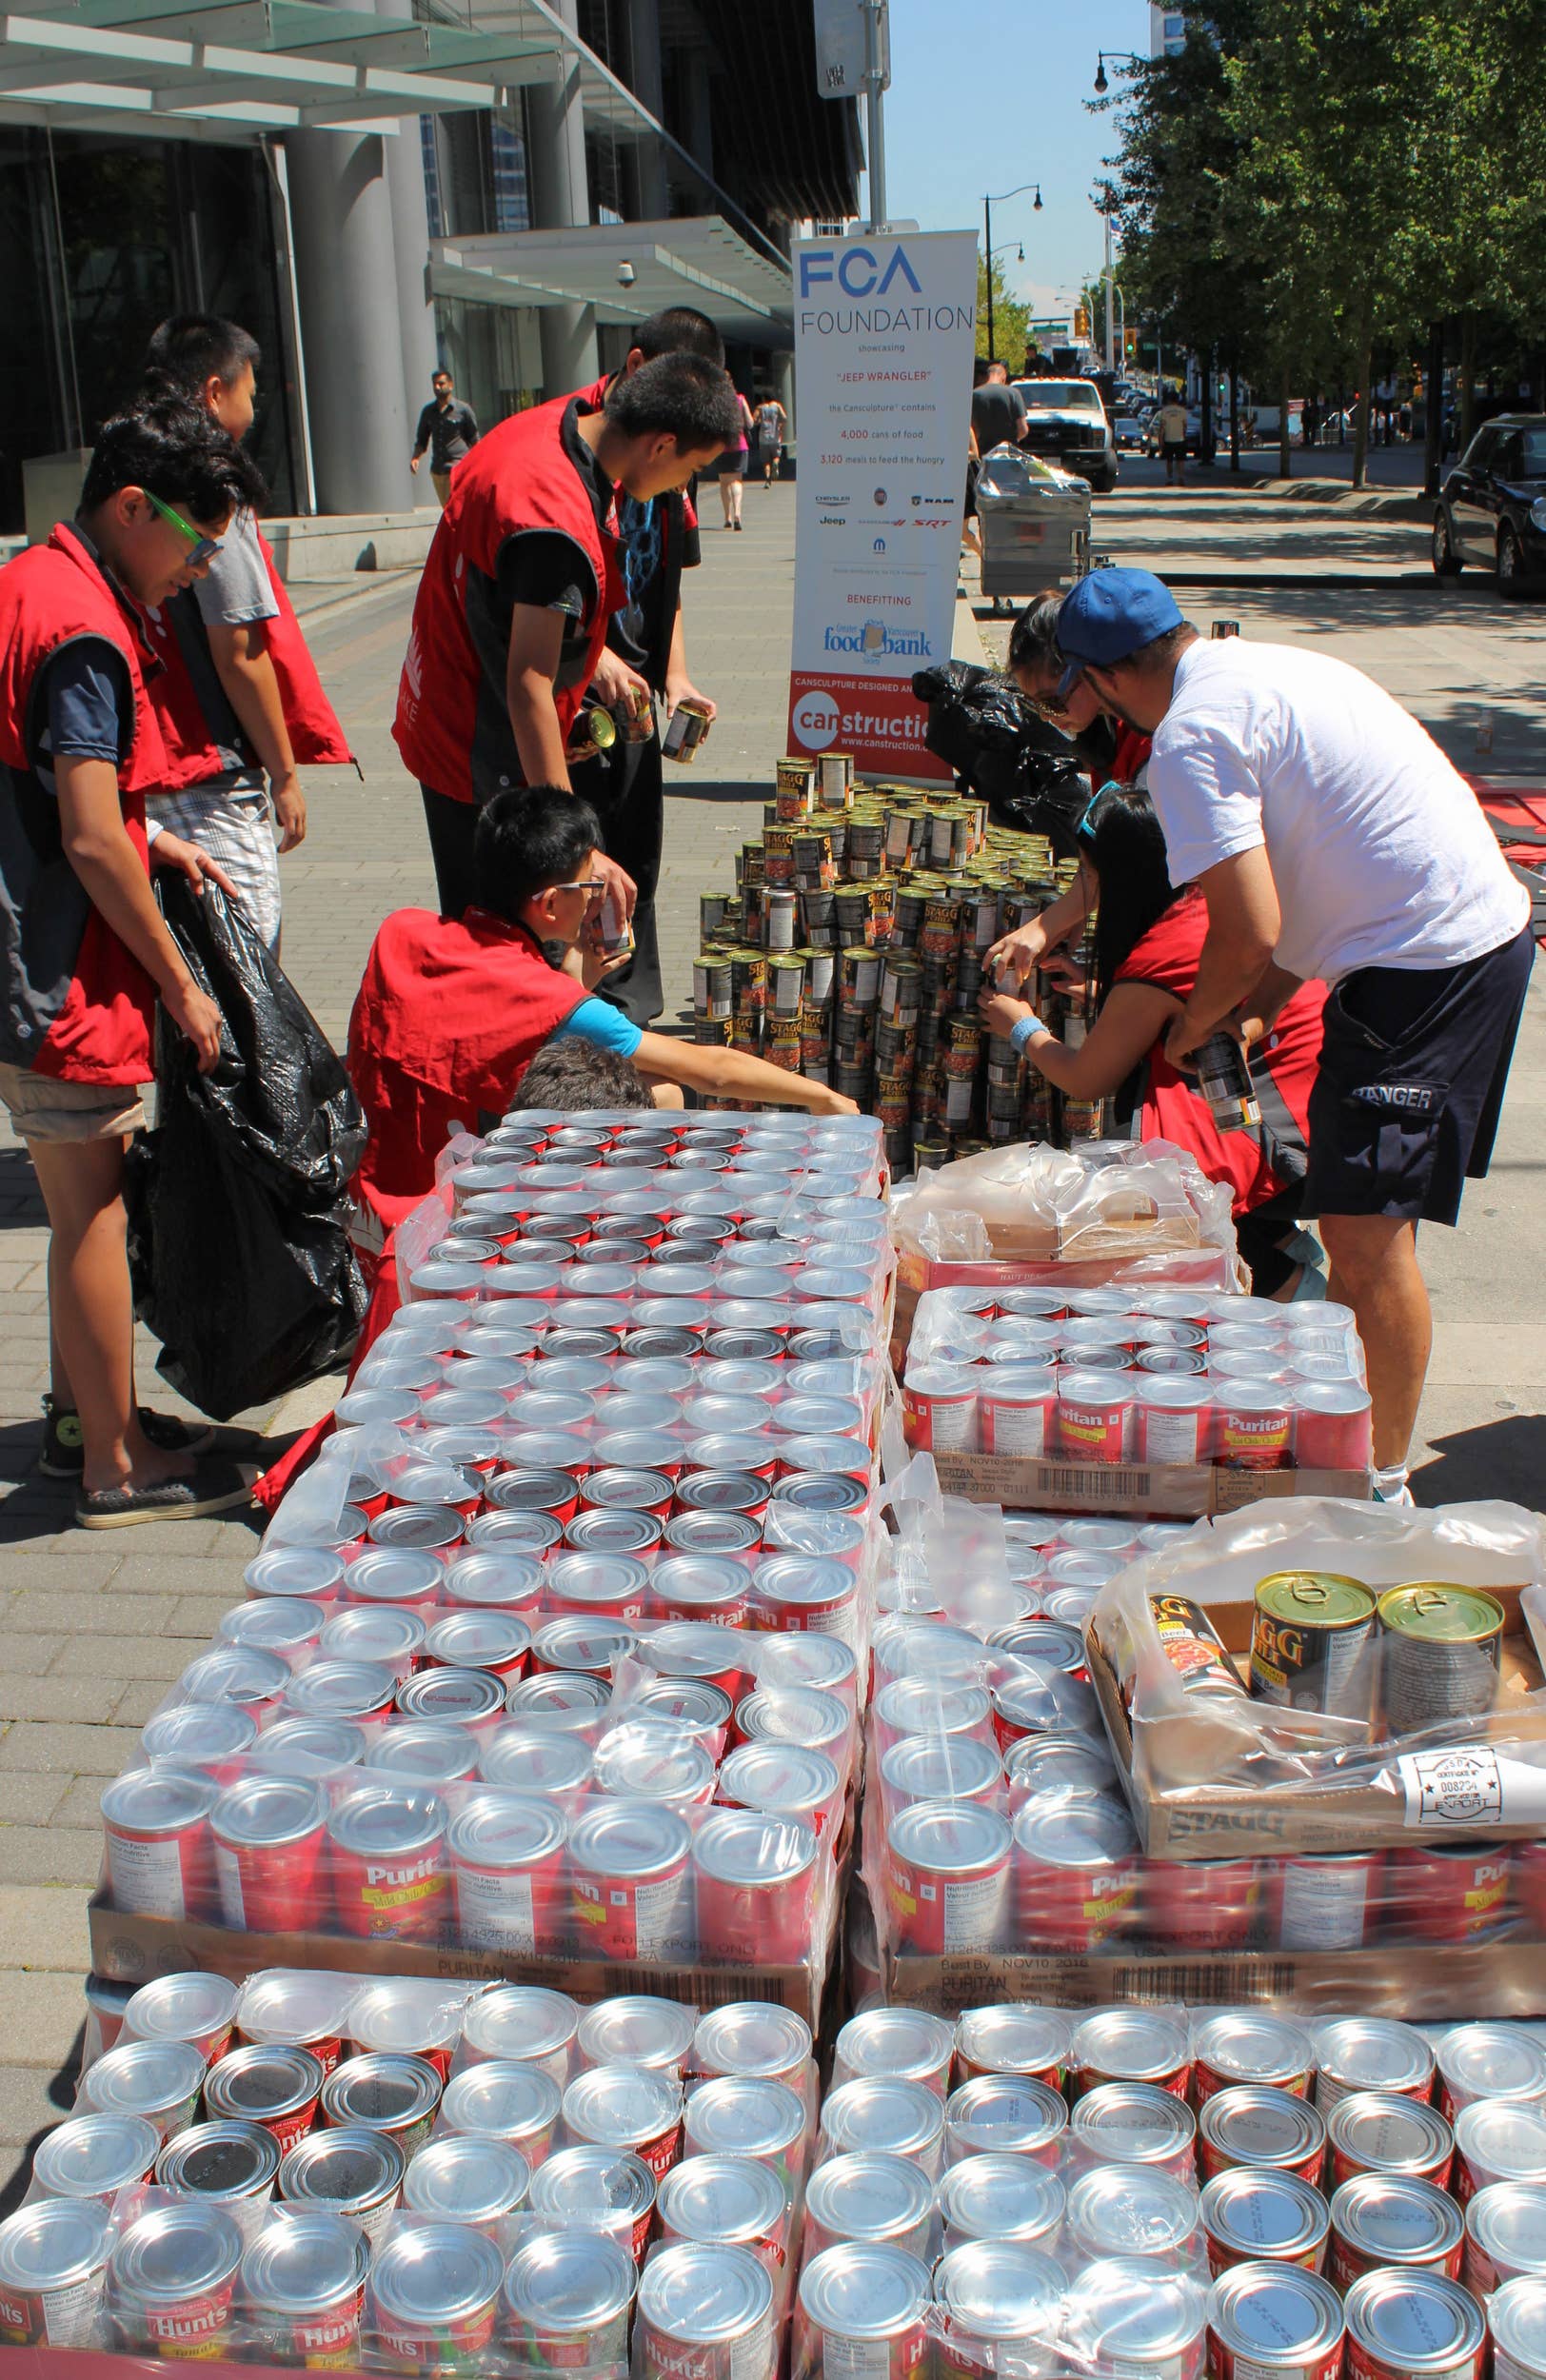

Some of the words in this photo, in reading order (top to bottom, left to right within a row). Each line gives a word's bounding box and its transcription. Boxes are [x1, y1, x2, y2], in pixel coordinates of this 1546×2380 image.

[799, 244, 922, 298] FCA
[801, 306, 973, 335] FOUNDATION
[858, 343, 905, 353] showcasing
[829, 404, 842, 412] the
[902, 403, 937, 412] contains
[841, 429, 868, 440] 4,000
[892, 430, 901, 439] of
[903, 430, 923, 439] food
[916, 456, 945, 466] hungry
[820, 516, 846, 526] Jeep
[912, 519, 952, 529] SRT
[847, 594, 912, 606] BENEFITTING
[823, 626, 865, 652] food
[882, 625, 932, 656] bank
[795, 678, 857, 689] CANSCULPTURE
[858, 682, 899, 692] DESIGNED
[901, 684, 913, 693] AN
[925, 906, 958, 918] STAGG
[803, 1012, 825, 1024] AGG
[770, 1022, 802, 1034] STAGG
[1227, 1415, 1288, 1433] Puritan
[1435, 1798, 1490, 1810] EXPORT
[367, 1856, 437, 1886] Purit
[946, 1882, 979, 1892] Nutrition
[438, 1960, 504, 1977] PURITAN
[974, 1959, 991, 1971] By
[1002, 1957, 1049, 1969] NOV10
[941, 1976, 1006, 1991] PURITAN
